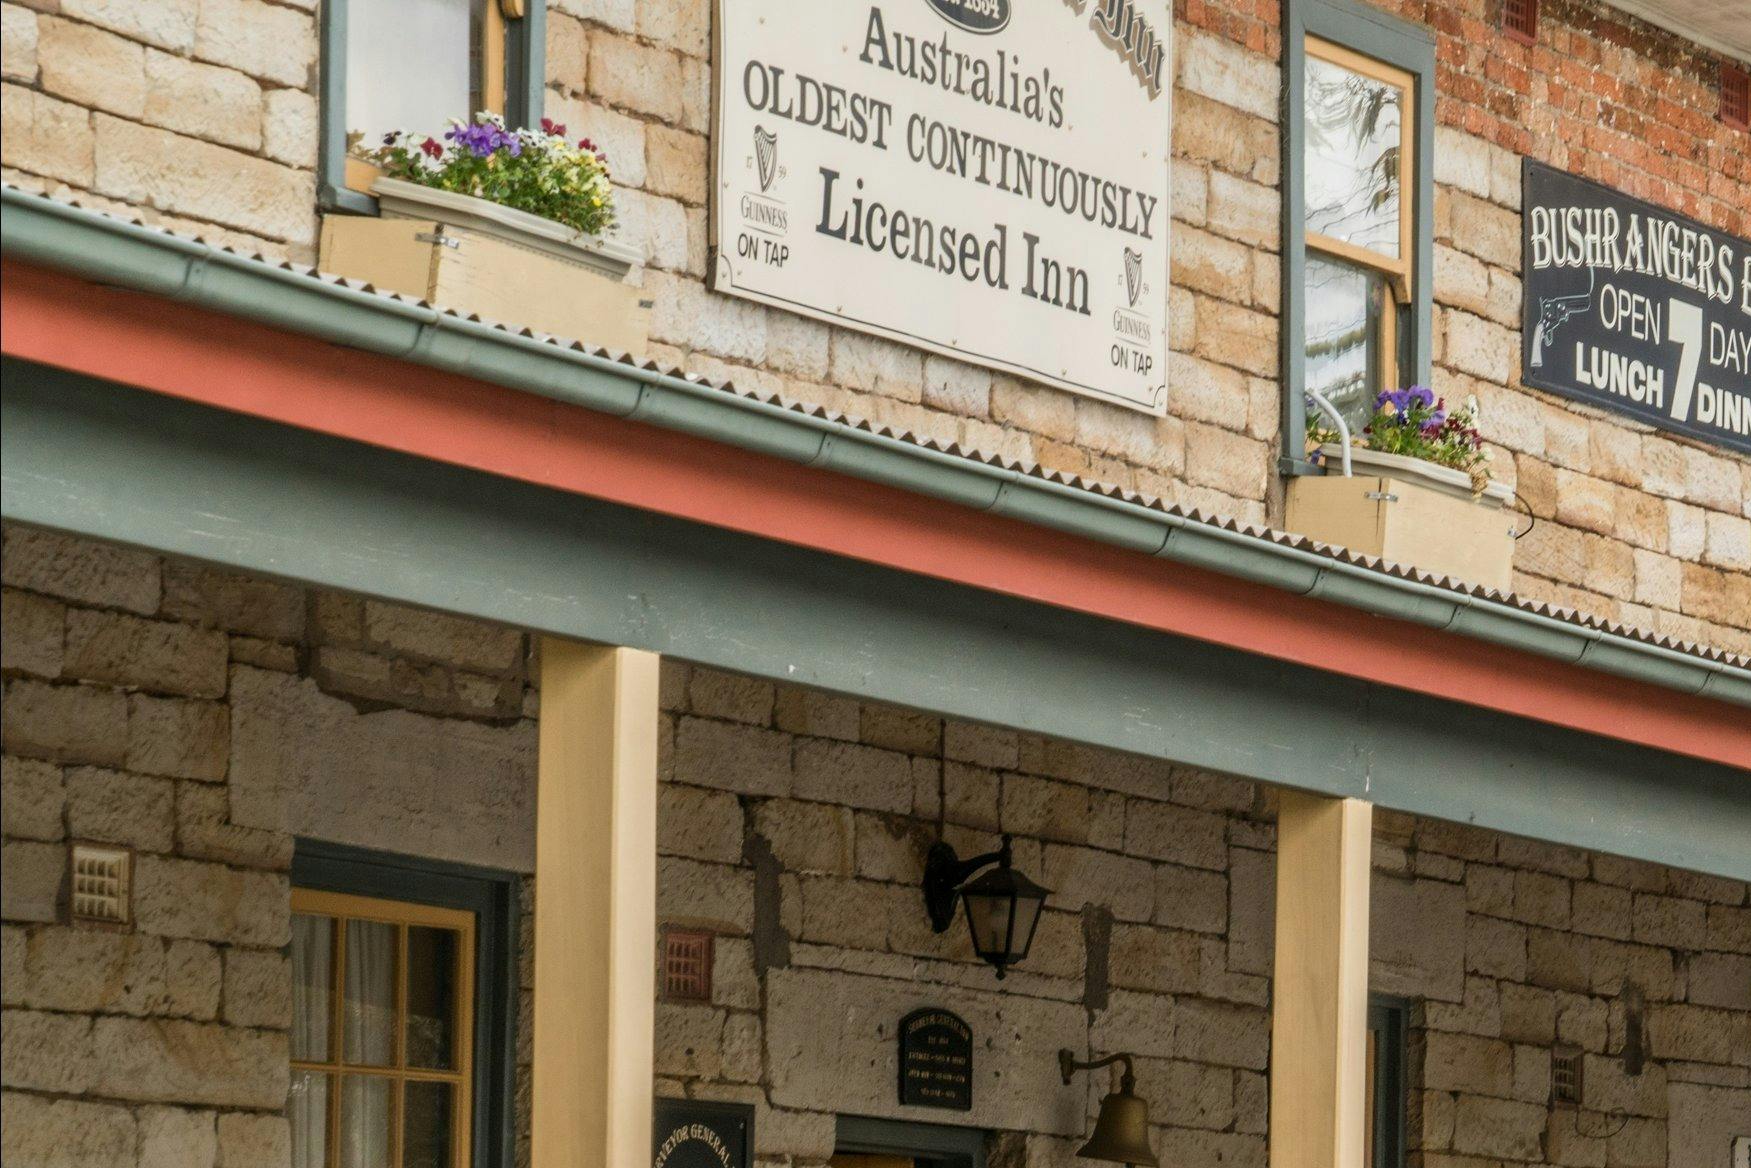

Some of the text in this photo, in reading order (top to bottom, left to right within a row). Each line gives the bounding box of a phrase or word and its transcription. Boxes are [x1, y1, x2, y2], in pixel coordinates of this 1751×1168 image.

[859, 6, 1064, 129] Australia's
[743, 59, 1158, 240] OLDEST CONTINUOUSLY
[741, 195, 788, 230] GUINNESS
[815, 166, 1092, 316] Licensed Inn
[737, 233, 789, 267] ON TAP
[1530, 205, 1734, 304] BUSHRANGERS
[1113, 309, 1151, 342] GUINNESS
[1600, 283, 1661, 345] OPEN
[1668, 297, 1703, 422] 7
[1111, 344, 1153, 376] ON TAP
[1575, 341, 1664, 408] LUNCH
[690, 1123, 730, 1168] GENERAL
